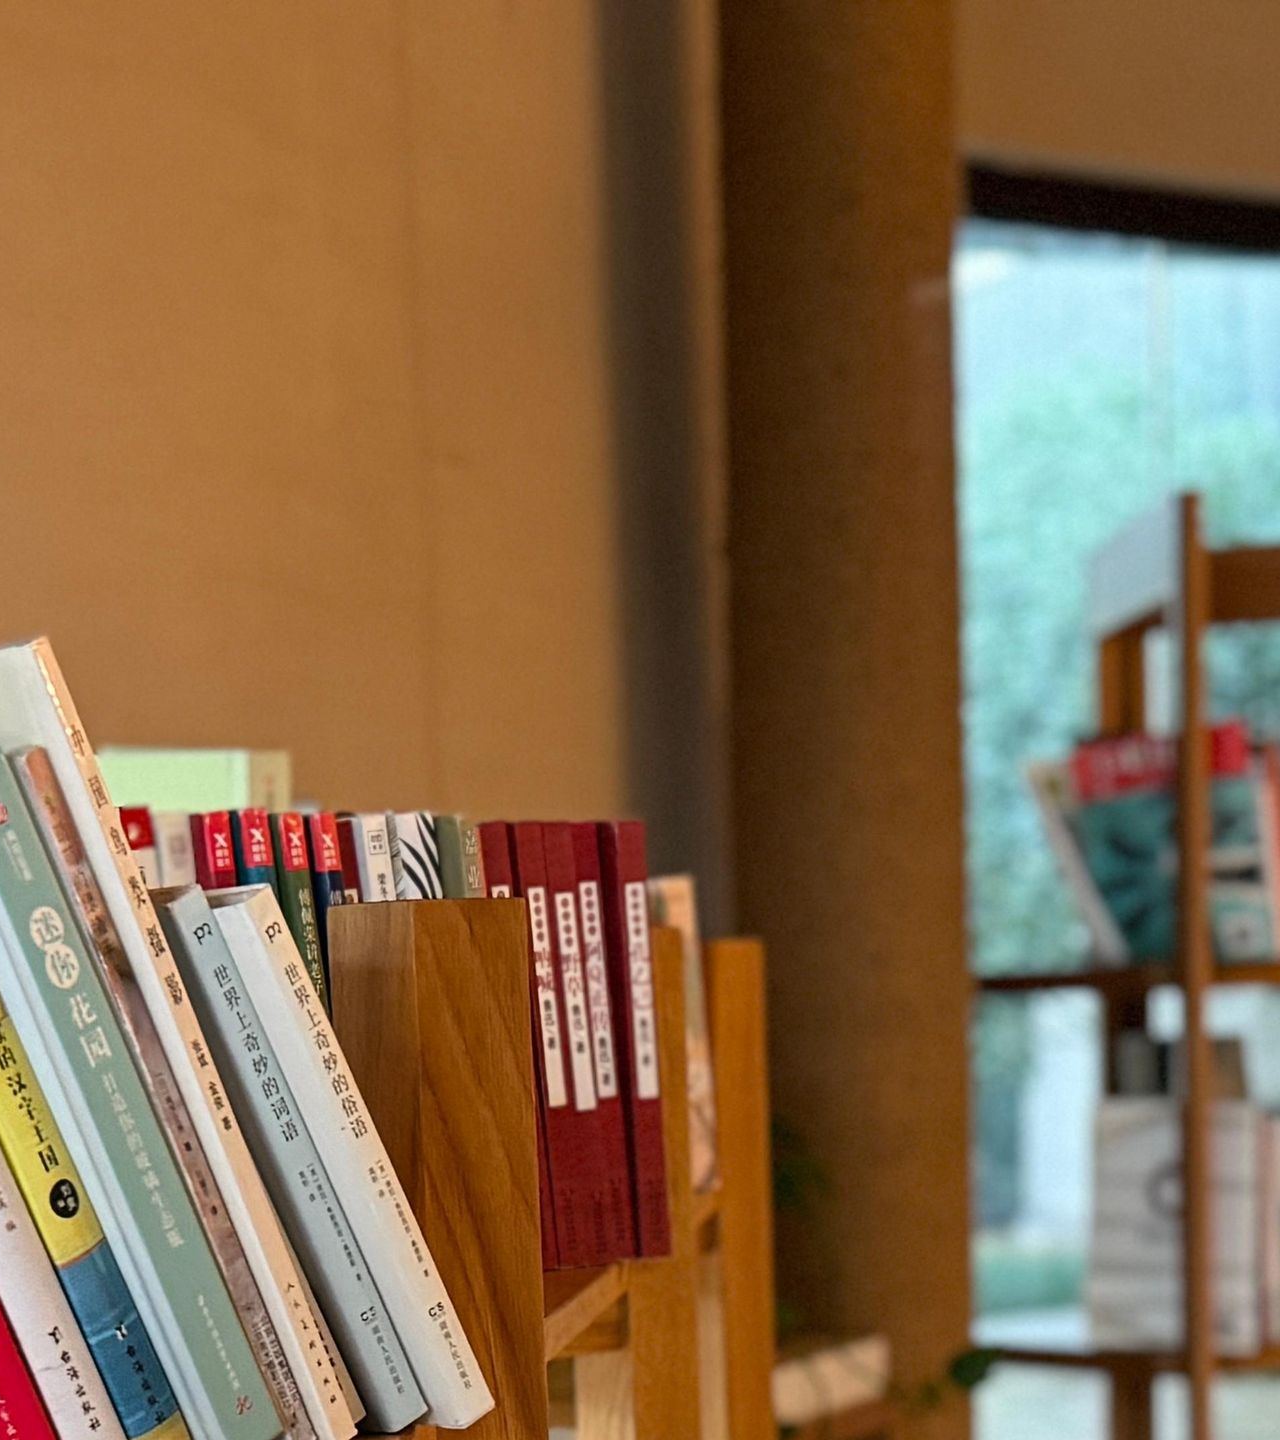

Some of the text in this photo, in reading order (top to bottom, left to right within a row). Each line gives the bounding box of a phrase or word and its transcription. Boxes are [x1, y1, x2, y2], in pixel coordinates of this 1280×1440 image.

[32, 908, 111, 1067] 迷你花园
[213, 964, 300, 1143] 世界上奇妙的词语
[282, 962, 367, 1141] 世界上奇妙的俗语
[59, 1349, 104, 1434] 台海出版社
